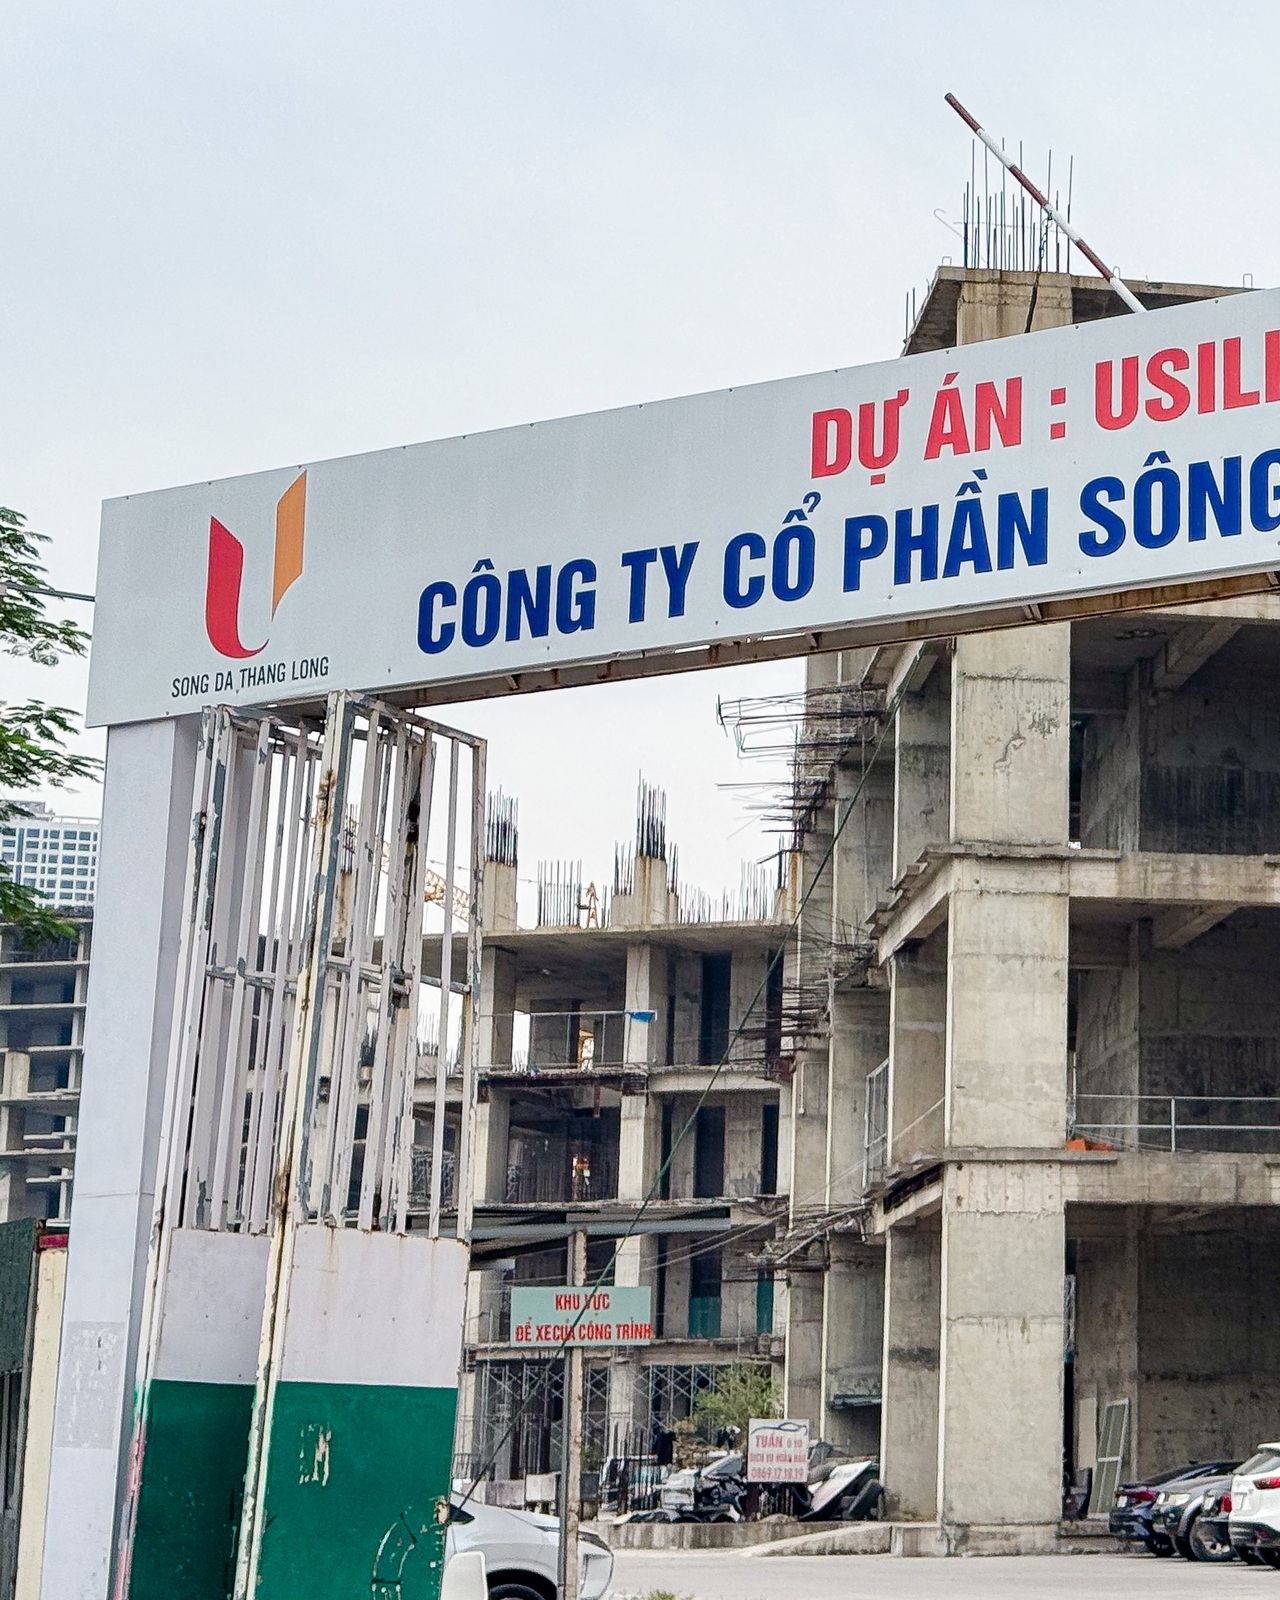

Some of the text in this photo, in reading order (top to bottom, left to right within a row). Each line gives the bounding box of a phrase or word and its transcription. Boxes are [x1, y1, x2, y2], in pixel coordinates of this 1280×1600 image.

[811, 387, 909, 485] DỰ
[924, 371, 1022, 461] ÁN
[417, 557, 597, 655] CÔNG
[621, 541, 701, 624] TY
[723, 490, 822, 609] CỔ
[843, 467, 1049, 593] PHẦN
[171, 656, 329, 698] SONG DA THANG LONG
[555, 1293, 580, 1311] KHU
[515, 1317, 532, 1342] ĐỂ
[579, 1320, 612, 1341] CÔNG
